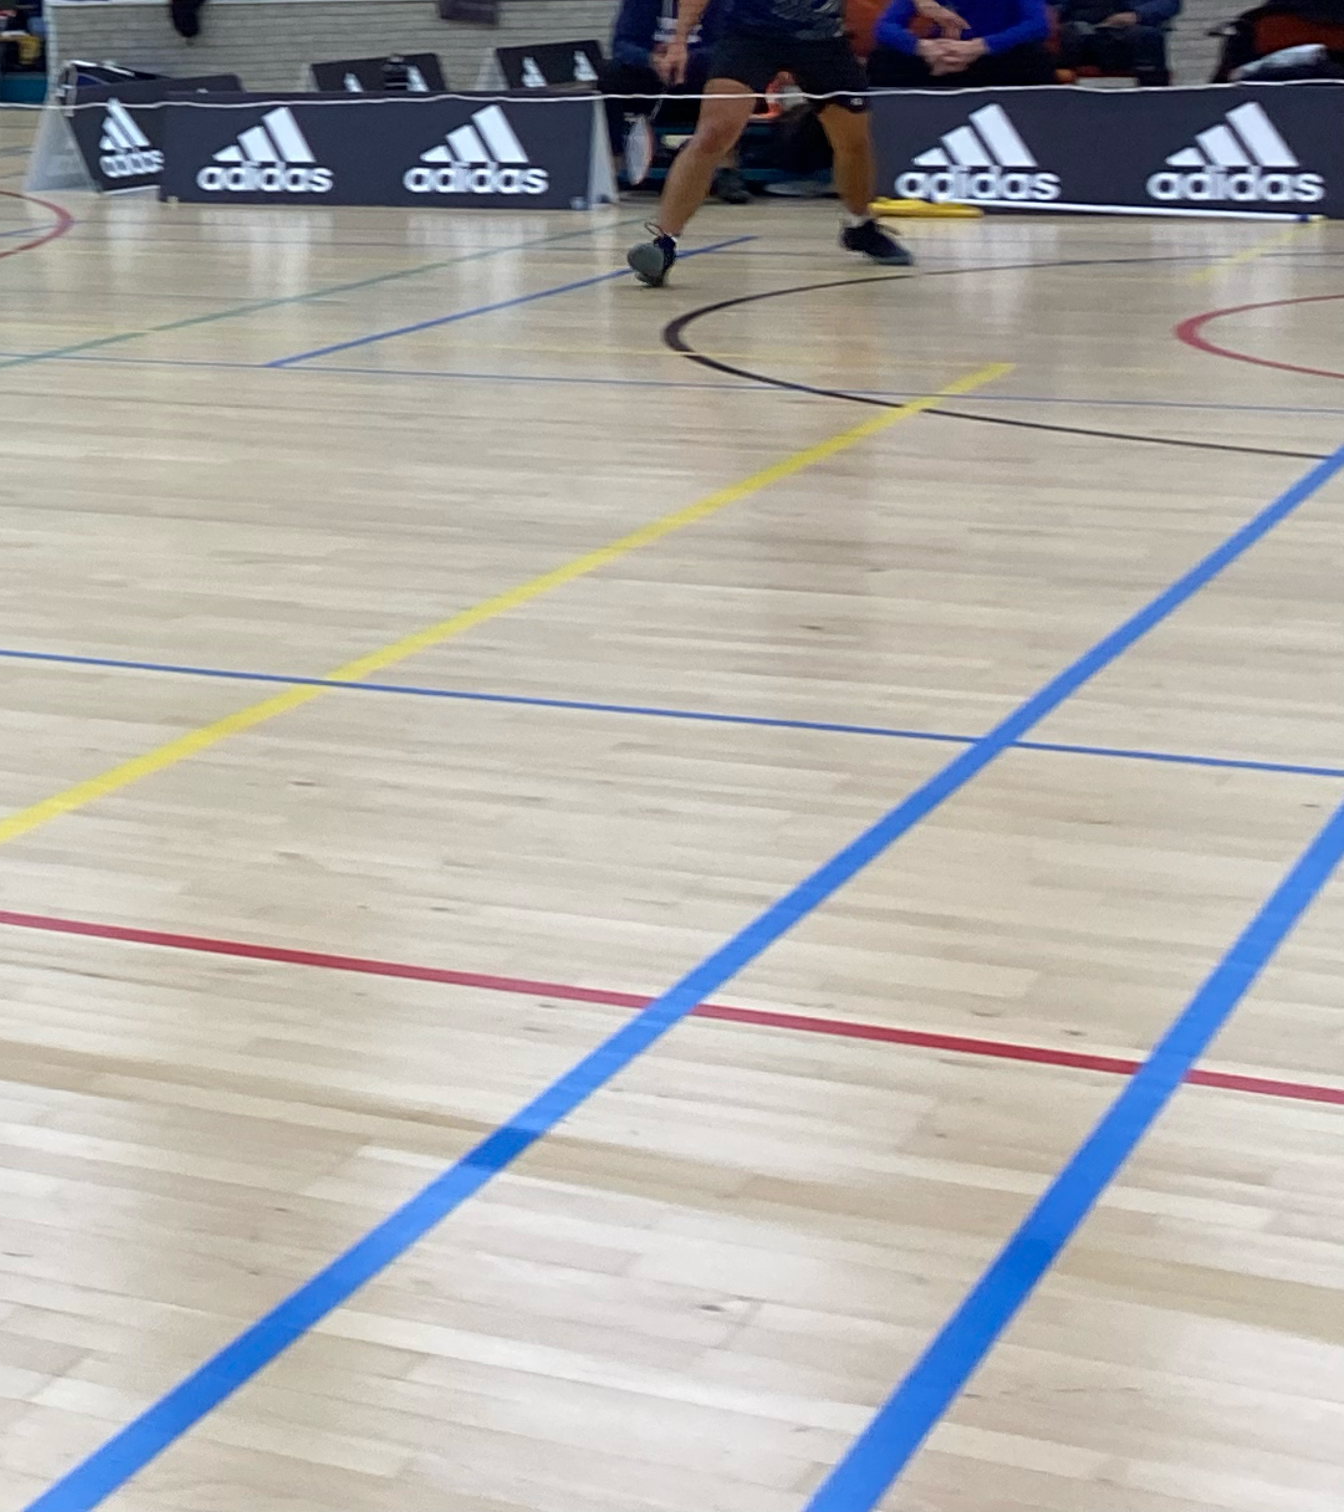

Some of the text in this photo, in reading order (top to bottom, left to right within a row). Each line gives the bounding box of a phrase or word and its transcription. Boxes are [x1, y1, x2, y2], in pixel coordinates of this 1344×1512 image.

[196, 161, 333, 193] adidas
[402, 161, 549, 194] adidas
[895, 165, 1061, 201] adidas
[1145, 165, 1325, 201] adidas
